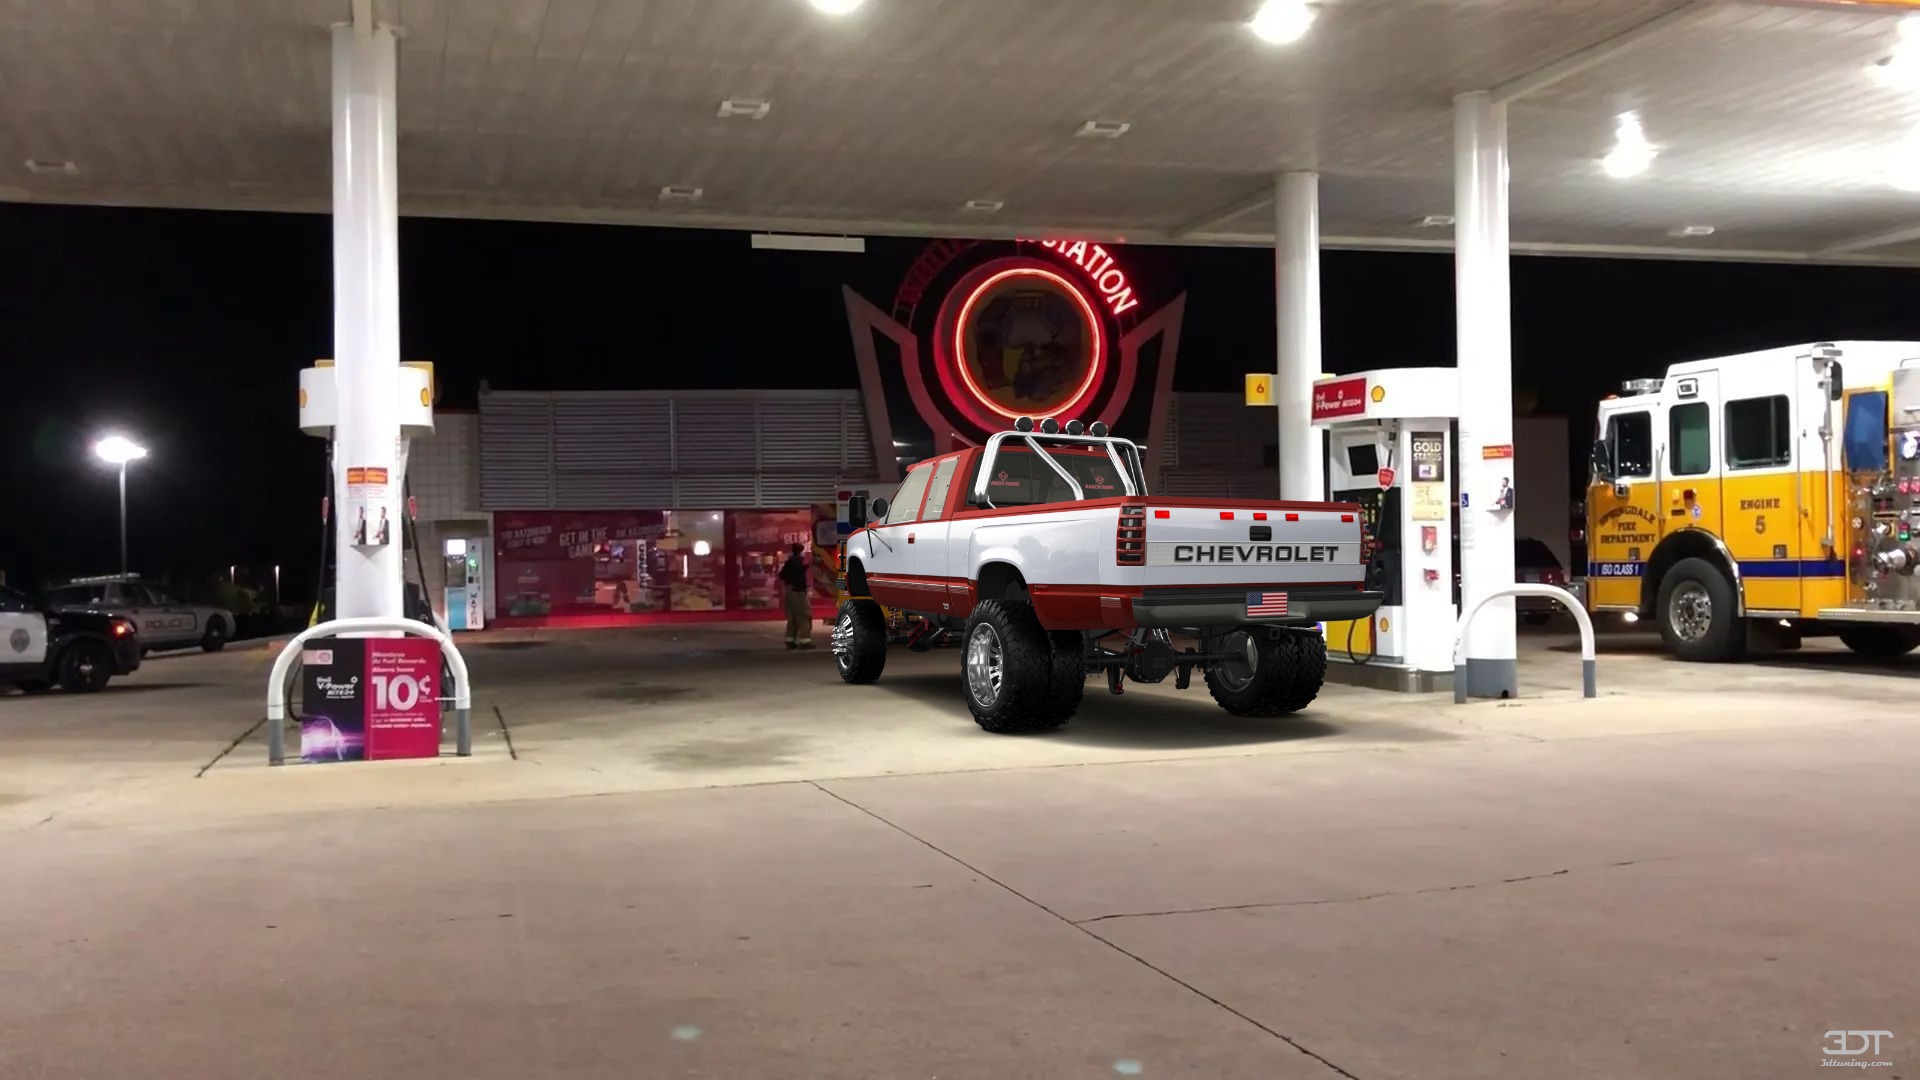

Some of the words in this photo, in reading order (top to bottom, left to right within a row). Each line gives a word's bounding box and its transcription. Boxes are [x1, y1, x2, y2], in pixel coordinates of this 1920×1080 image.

[1256, 383, 1265, 394] 6
[1413, 442, 1442, 453] GOLD
[1413, 453, 1442, 462] STATUS
[1740, 498, 1780, 511] ENGINE
[1599, 505, 1656, 526] SPRINGDALE
[1618, 521, 1636, 531] FIRE
[1755, 515, 1766, 534] 5
[559, 531, 576, 547] GET
[578, 528, 589, 543] IN
[1600, 534, 1655, 543] DEPARTMENT
[1174, 545, 1339, 562] CHEVROLET
[1601, 564, 1613, 575] ISO
[1613, 563, 1634, 575] CLASS
[1634, 564, 1639, 574] 1
[316, 682, 354, 690] V-Power
